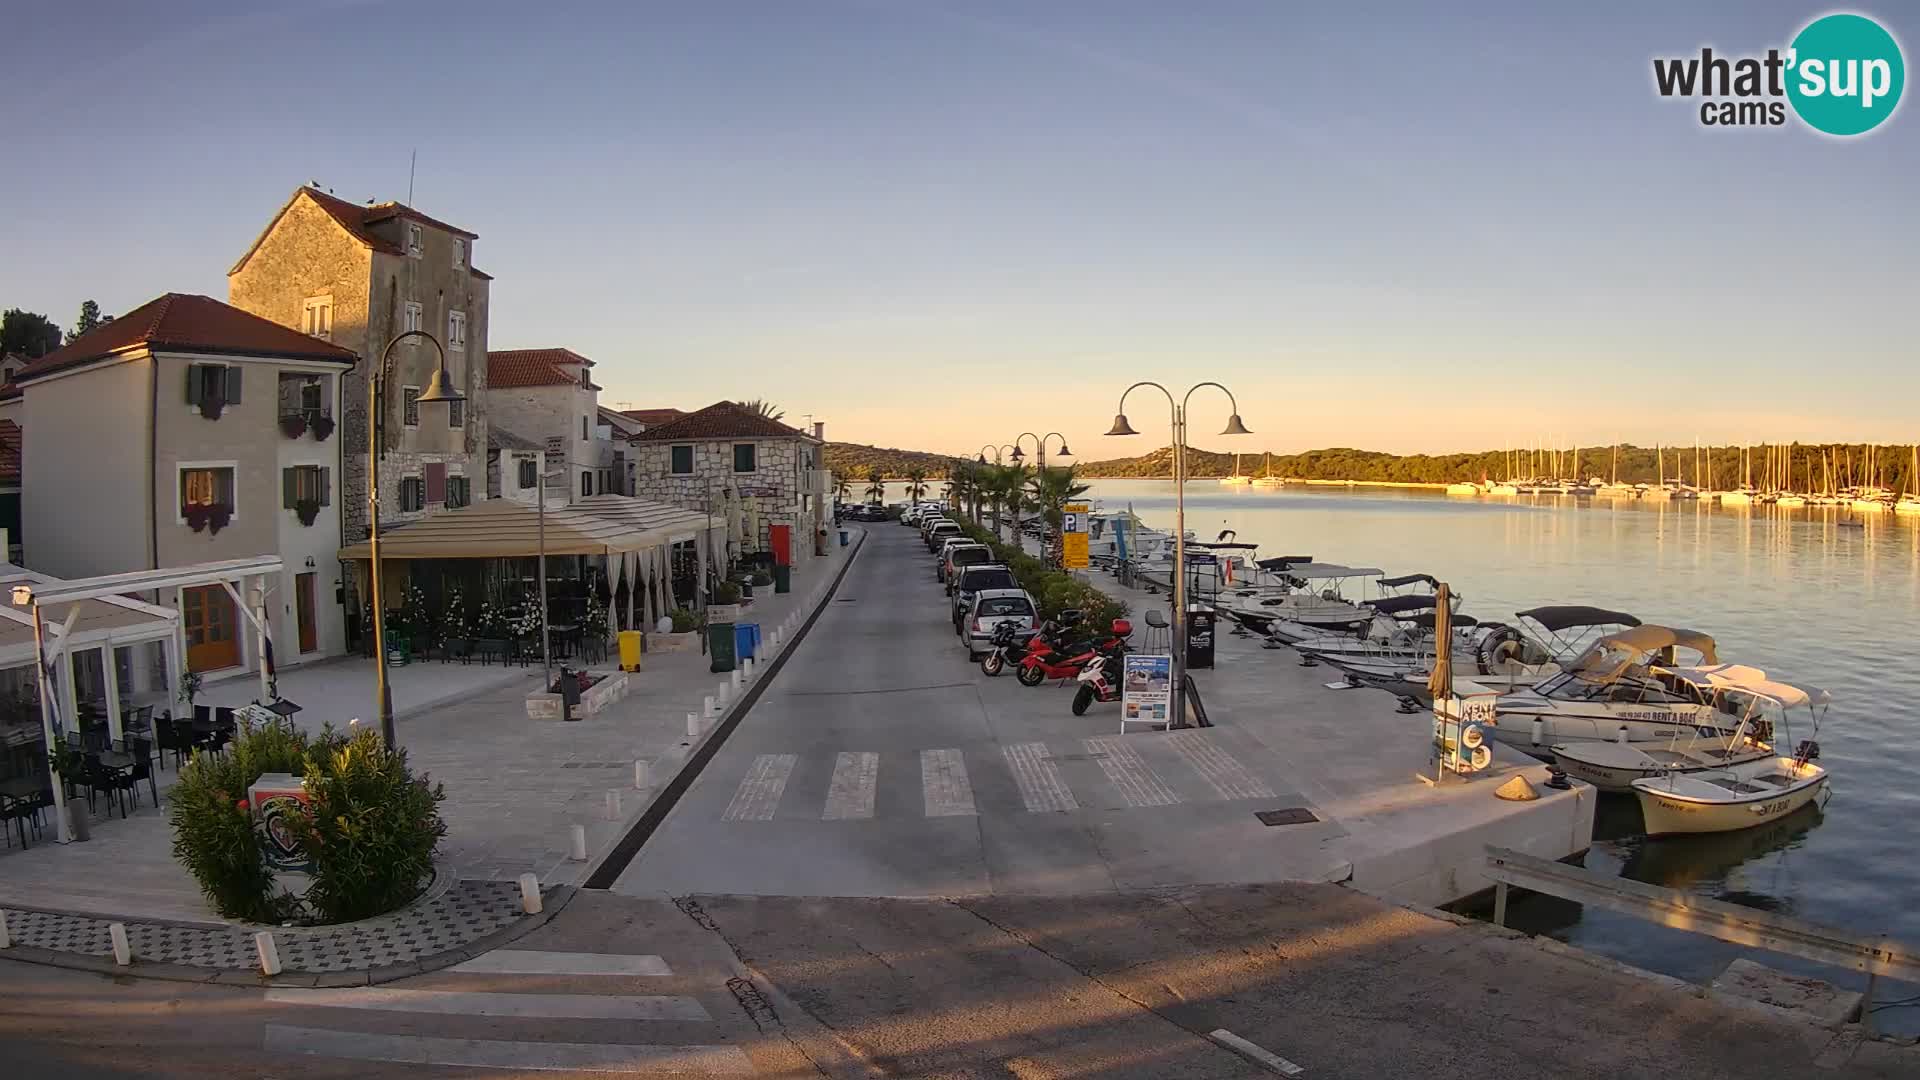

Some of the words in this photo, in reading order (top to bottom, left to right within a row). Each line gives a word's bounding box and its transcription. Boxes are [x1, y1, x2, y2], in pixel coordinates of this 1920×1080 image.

[1065, 514, 1076, 531] P
[1463, 702, 1496, 713] RENT
[1463, 713, 1470, 722] A
[1472, 712, 1496, 721] BOAT
[1652, 711, 1671, 721] RENT
[1672, 712, 1679, 722] A
[1679, 712, 1697, 724] BOAT
